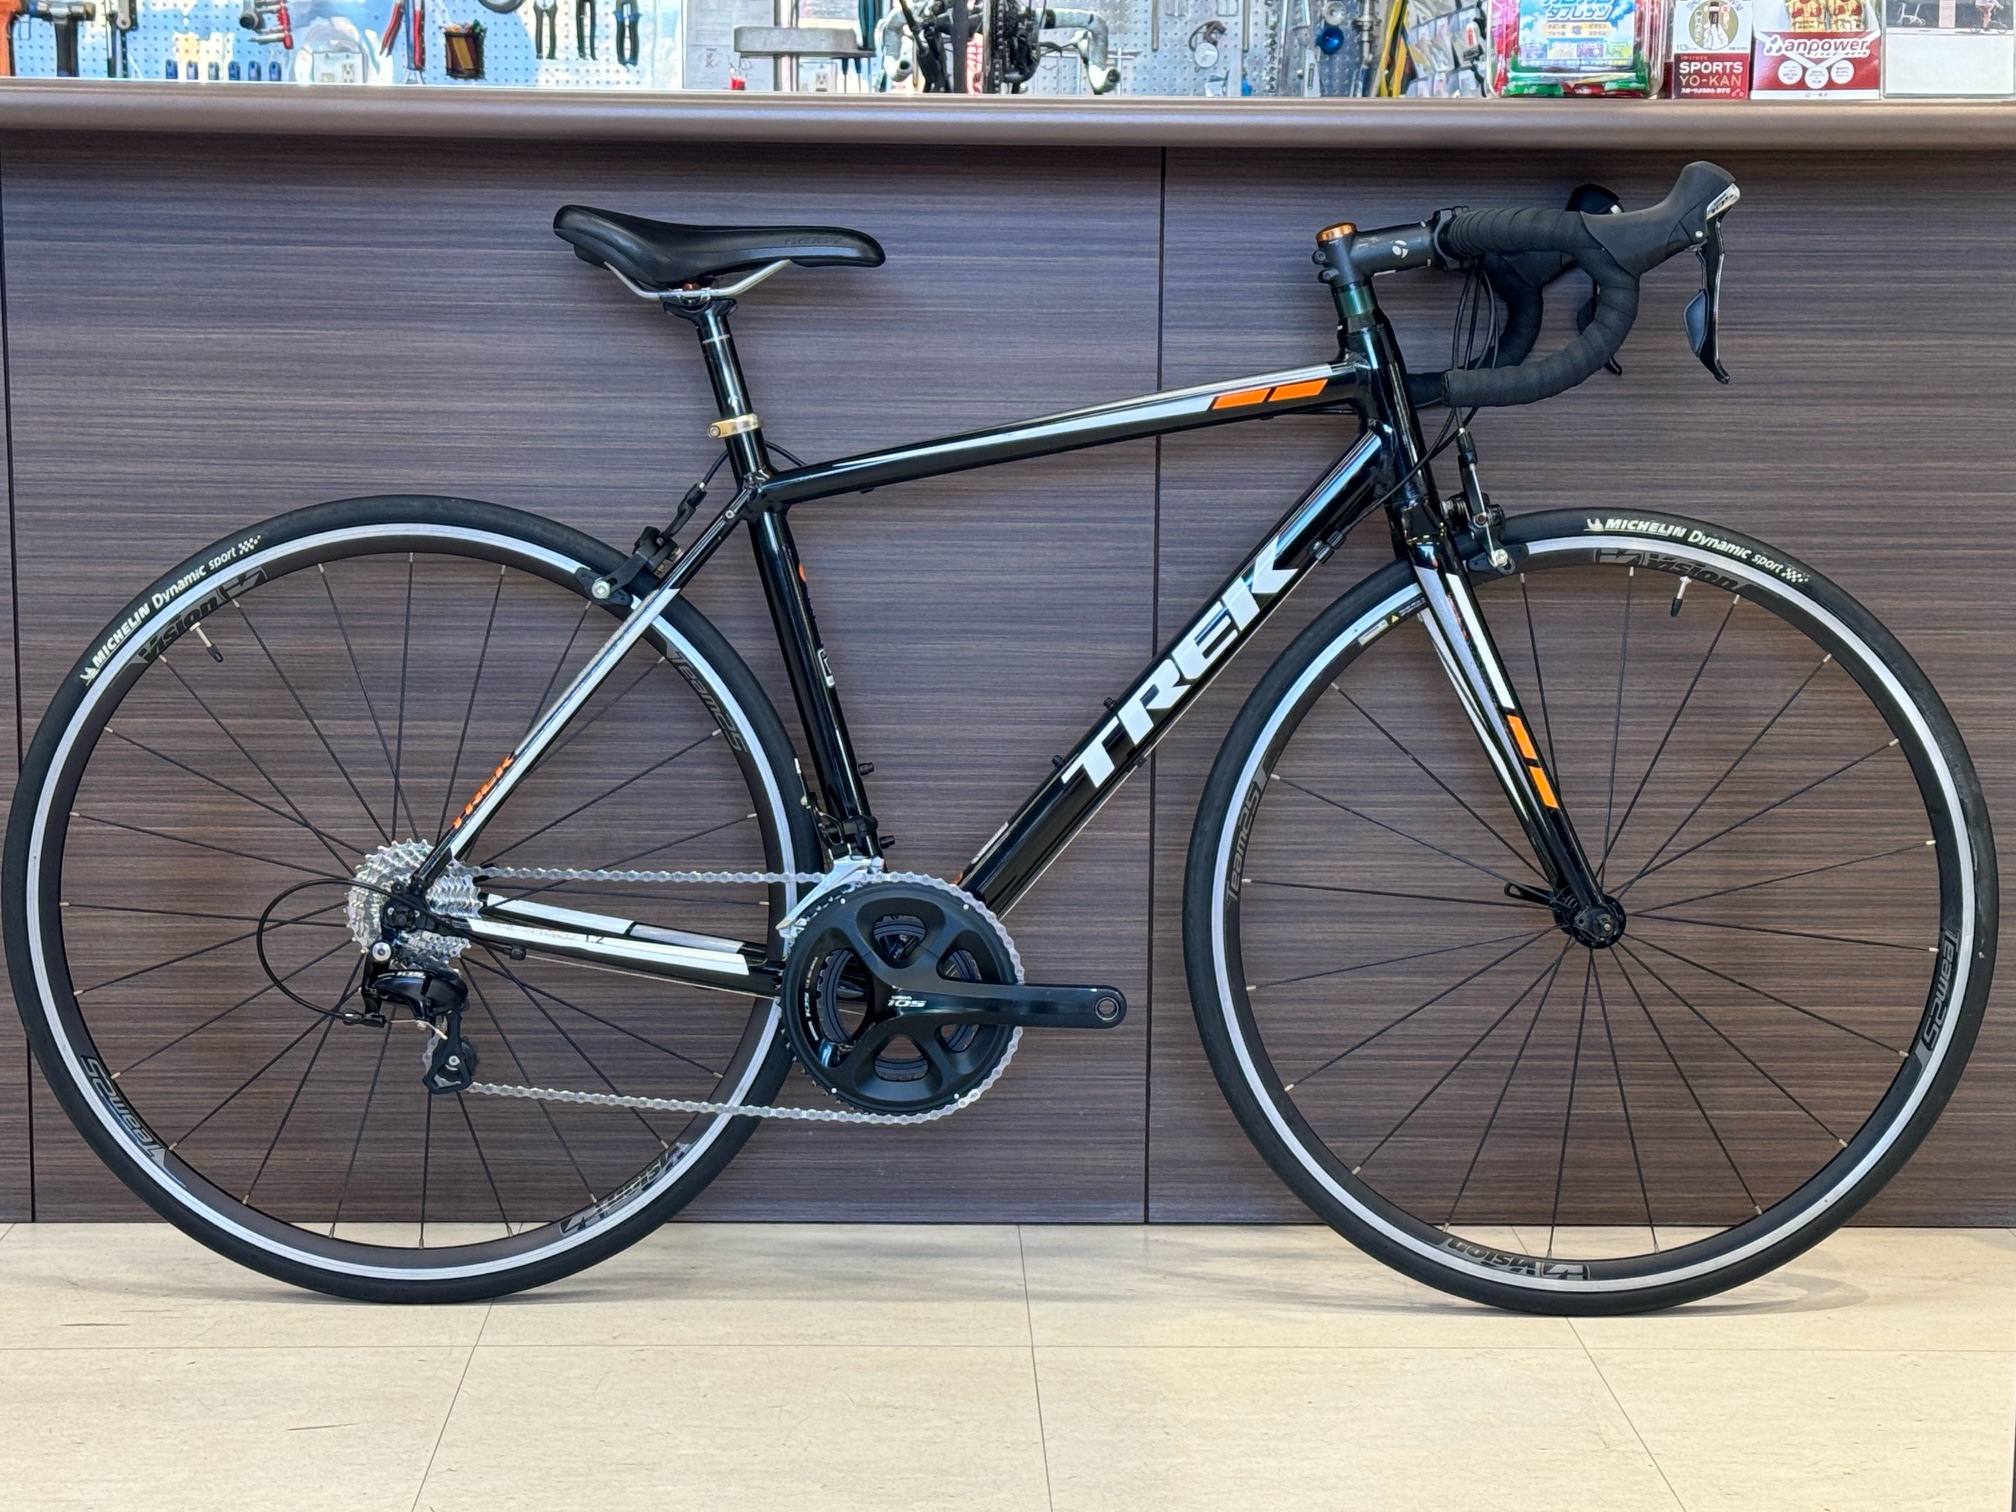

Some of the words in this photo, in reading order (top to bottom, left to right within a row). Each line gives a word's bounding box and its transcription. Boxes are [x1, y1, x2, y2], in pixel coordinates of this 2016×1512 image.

[1679, 61, 1743, 74] SPORTS
[1679, 75, 1742, 86] YO-KAN
[1605, 518, 1687, 538] MICHELIN
[1687, 529, 1753, 560] Dynamic
[1752, 552, 1783, 574] sport
[92, 602, 151, 669] MICHELIN
[151, 565, 207, 609] Dynamic
[208, 546, 237, 570] sport
[138, 595, 218, 663] Vision
[1061, 535, 1299, 789] TREK
[887, 1000, 927, 1008] 105
